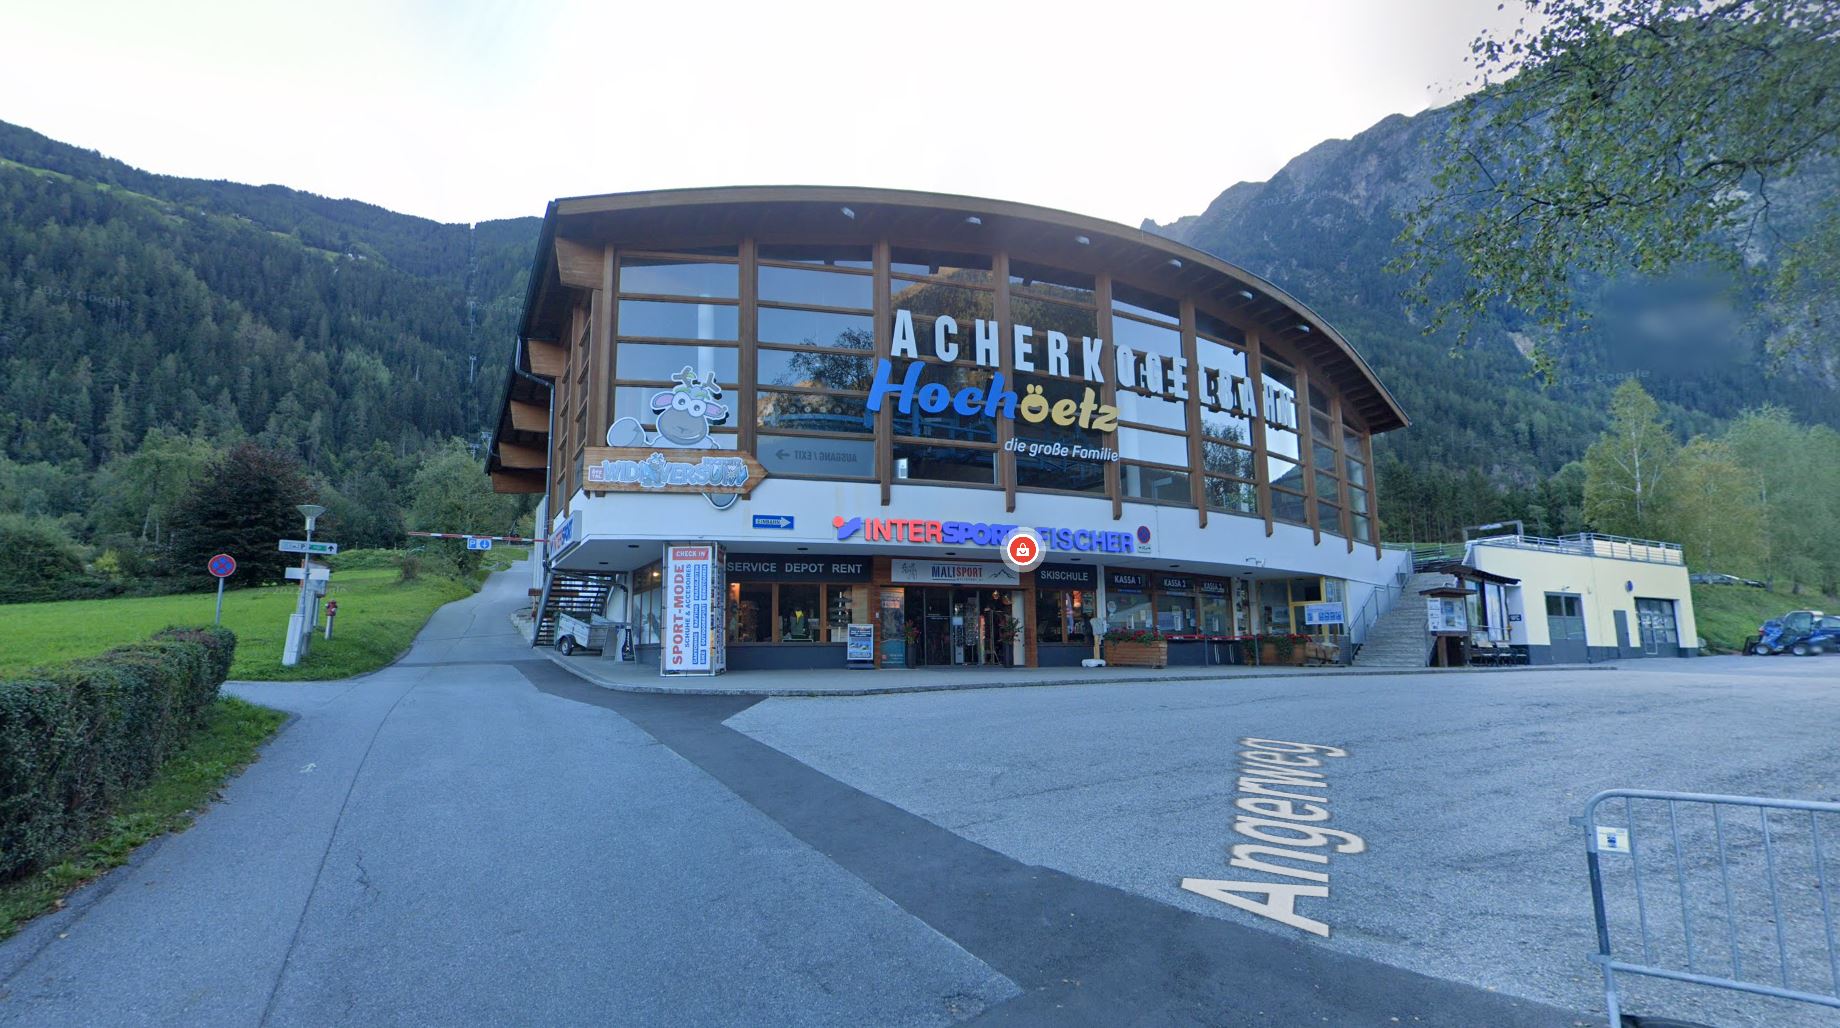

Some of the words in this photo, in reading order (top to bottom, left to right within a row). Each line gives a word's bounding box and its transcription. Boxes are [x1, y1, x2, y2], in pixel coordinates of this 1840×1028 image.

[1004, 438, 1025, 453] die
[1029, 441, 1068, 458] große
[1072, 445, 1119, 462] Familie
[864, 516, 1019, 548] INTERSPORT
[1034, 526, 1135, 553] FISCHER
[676, 550, 697, 558] CHECK
[727, 562, 777, 572] SERVICE
[785, 562, 825, 573] DEPOT
[832, 563, 863, 574] RENT
[931, 565, 983, 579] MALISPORT
[1040, 570, 1089, 582] SKISCHULE
[1114, 575, 1136, 585] KASSA
[1163, 578, 1182, 588] KASSA
[672, 564, 685, 665] SPORT-MODE
